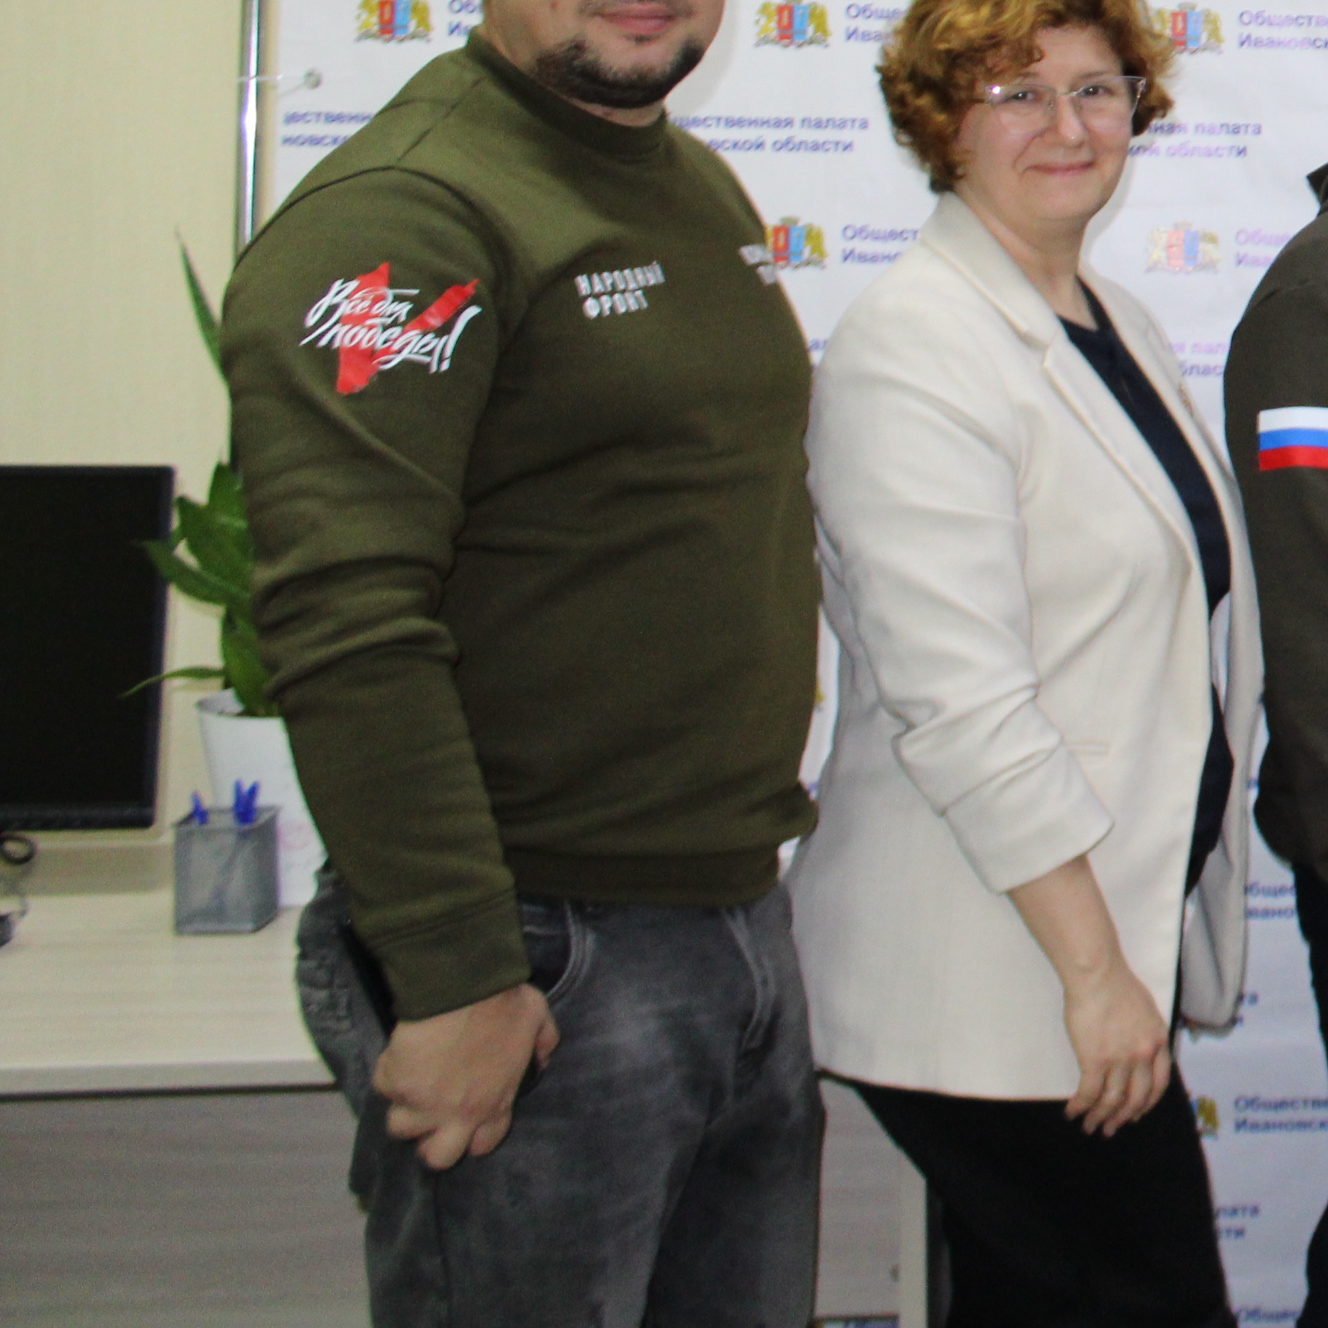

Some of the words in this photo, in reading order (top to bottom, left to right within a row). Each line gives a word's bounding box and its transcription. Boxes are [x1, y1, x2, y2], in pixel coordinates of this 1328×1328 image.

[799, 116, 870, 131] палата
[1193, 122, 1261, 136] палата
[771, 137, 854, 154] области
[1166, 141, 1247, 159] области
